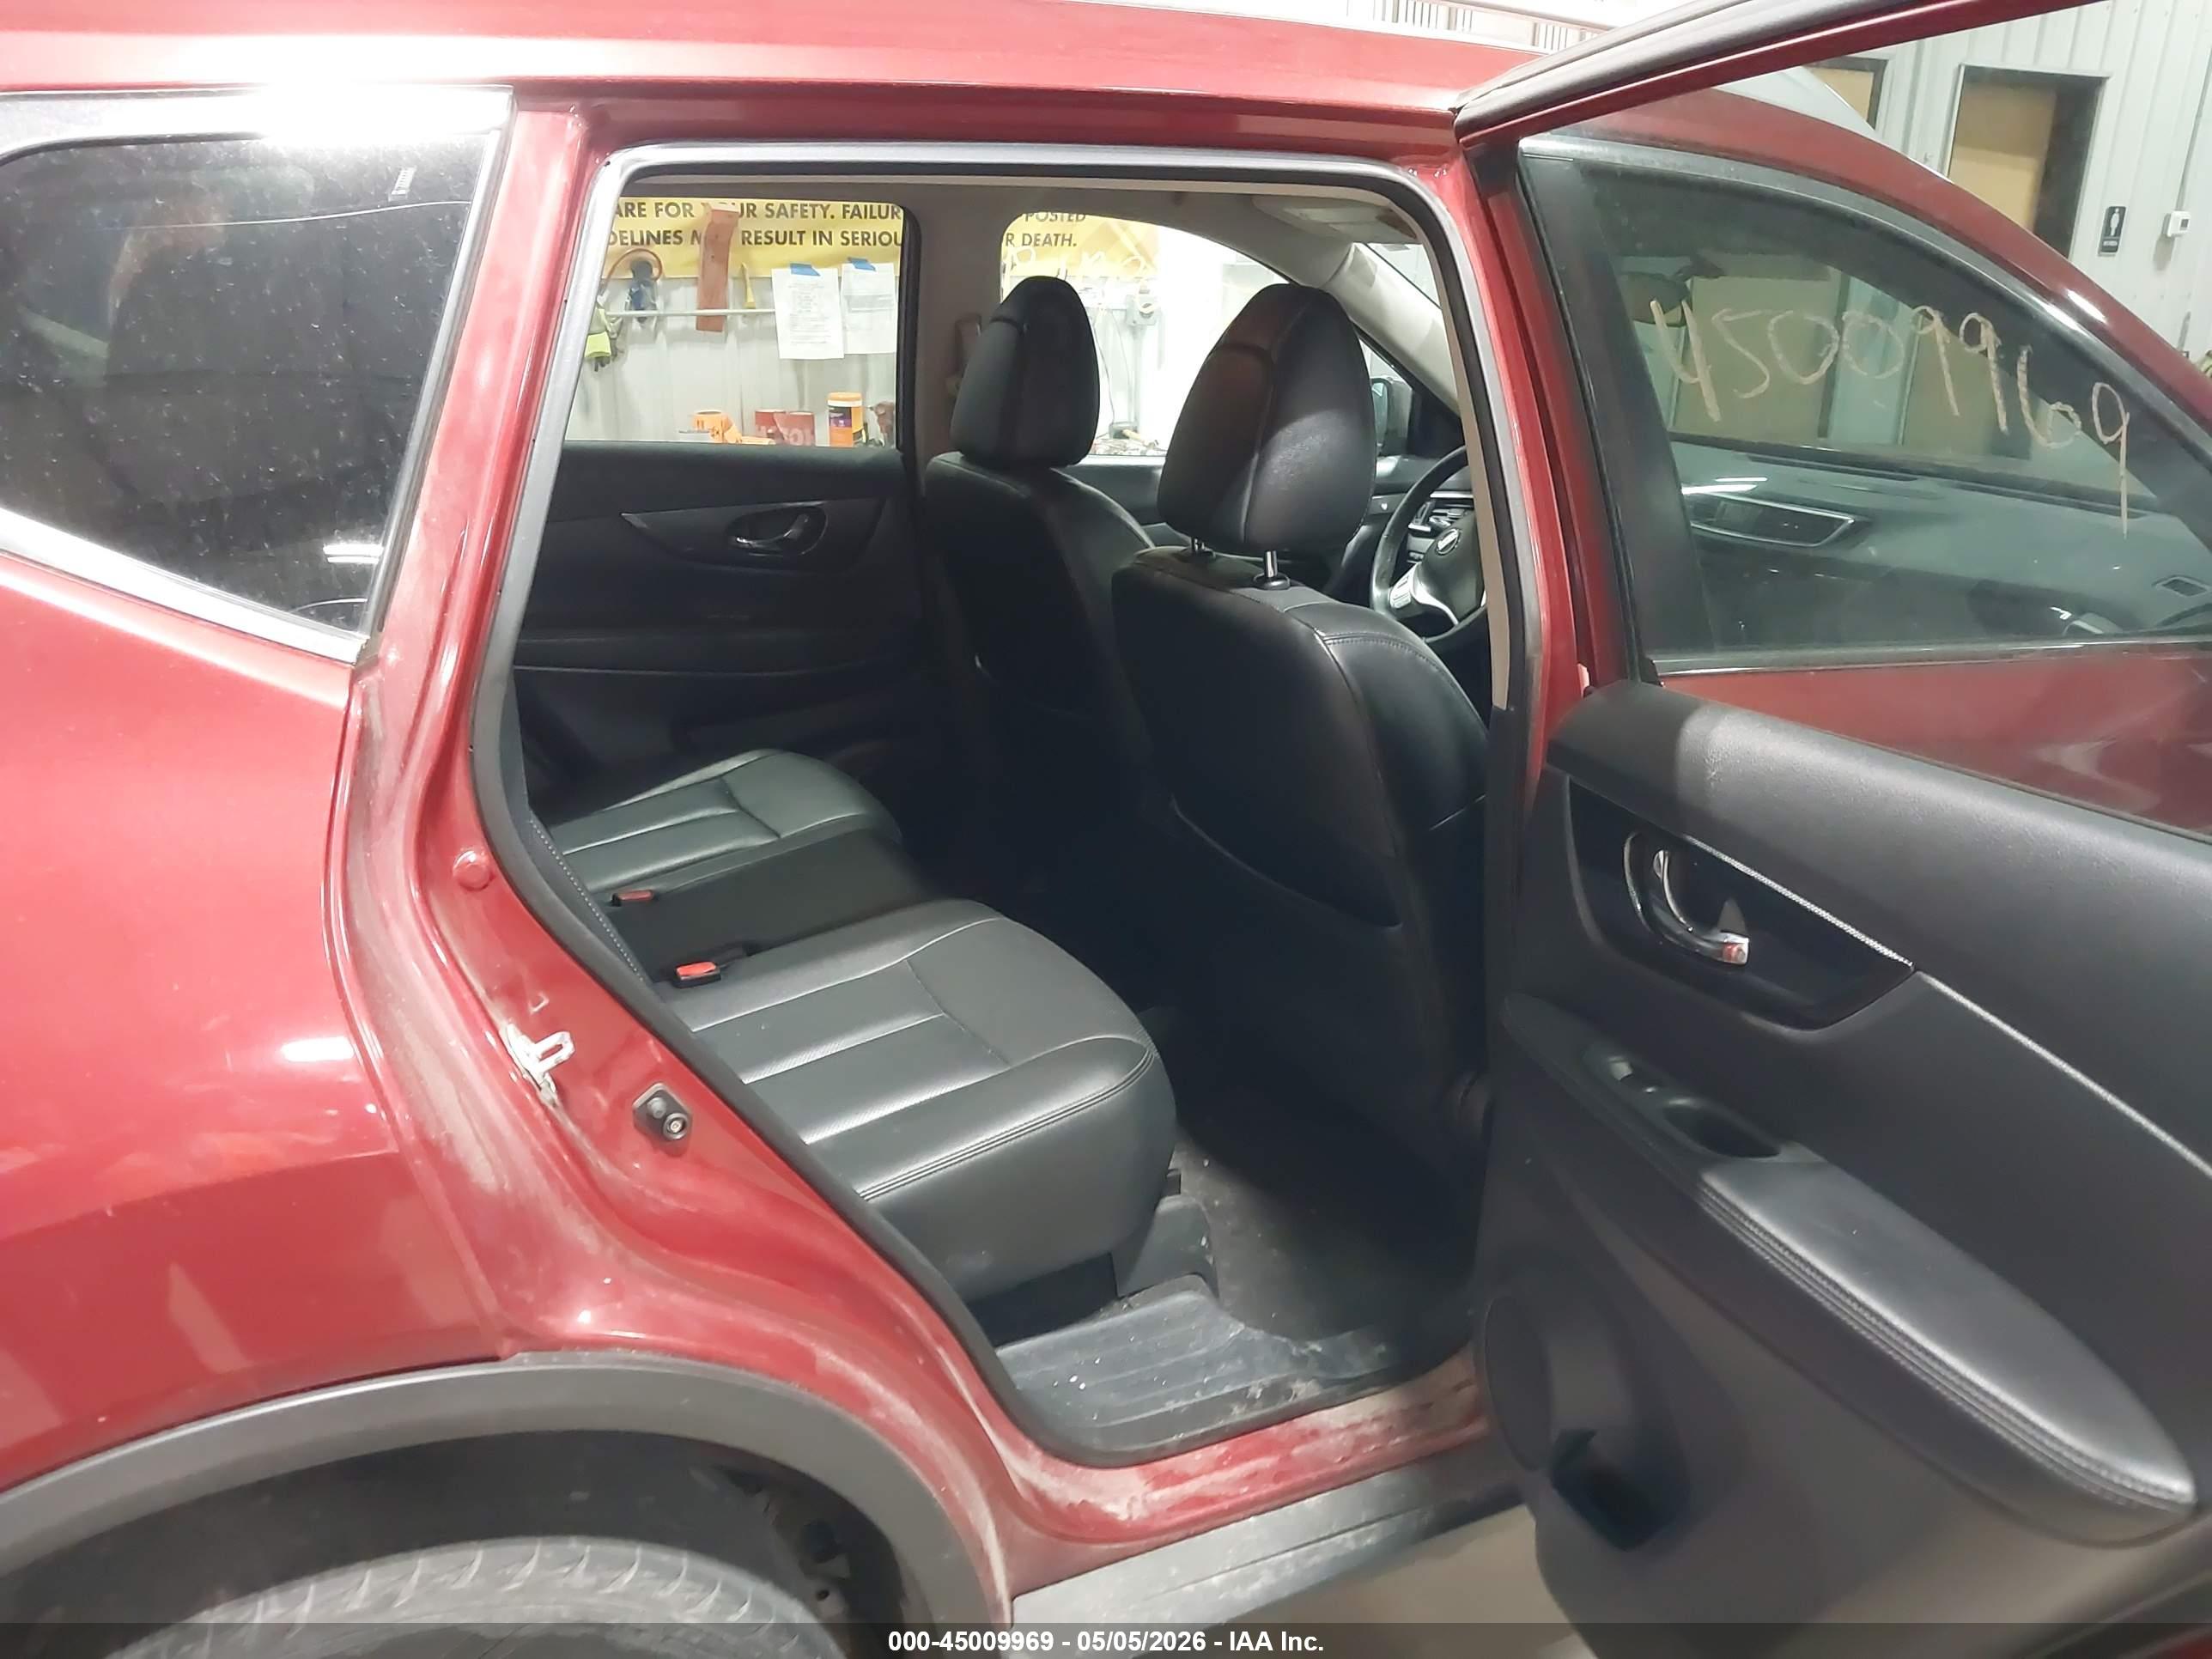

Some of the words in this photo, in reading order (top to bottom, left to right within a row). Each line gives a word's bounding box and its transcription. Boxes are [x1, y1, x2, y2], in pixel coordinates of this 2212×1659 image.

[654, 202, 695, 218] FOR
[765, 203, 835, 219] SAFETY.
[842, 204, 902, 221] FAILUR
[741, 229, 806, 246] RESULT
[812, 229, 833, 246] IN
[1022, 233, 1078, 247] DEATH.
[1650, 300, 2130, 539] 45009969
